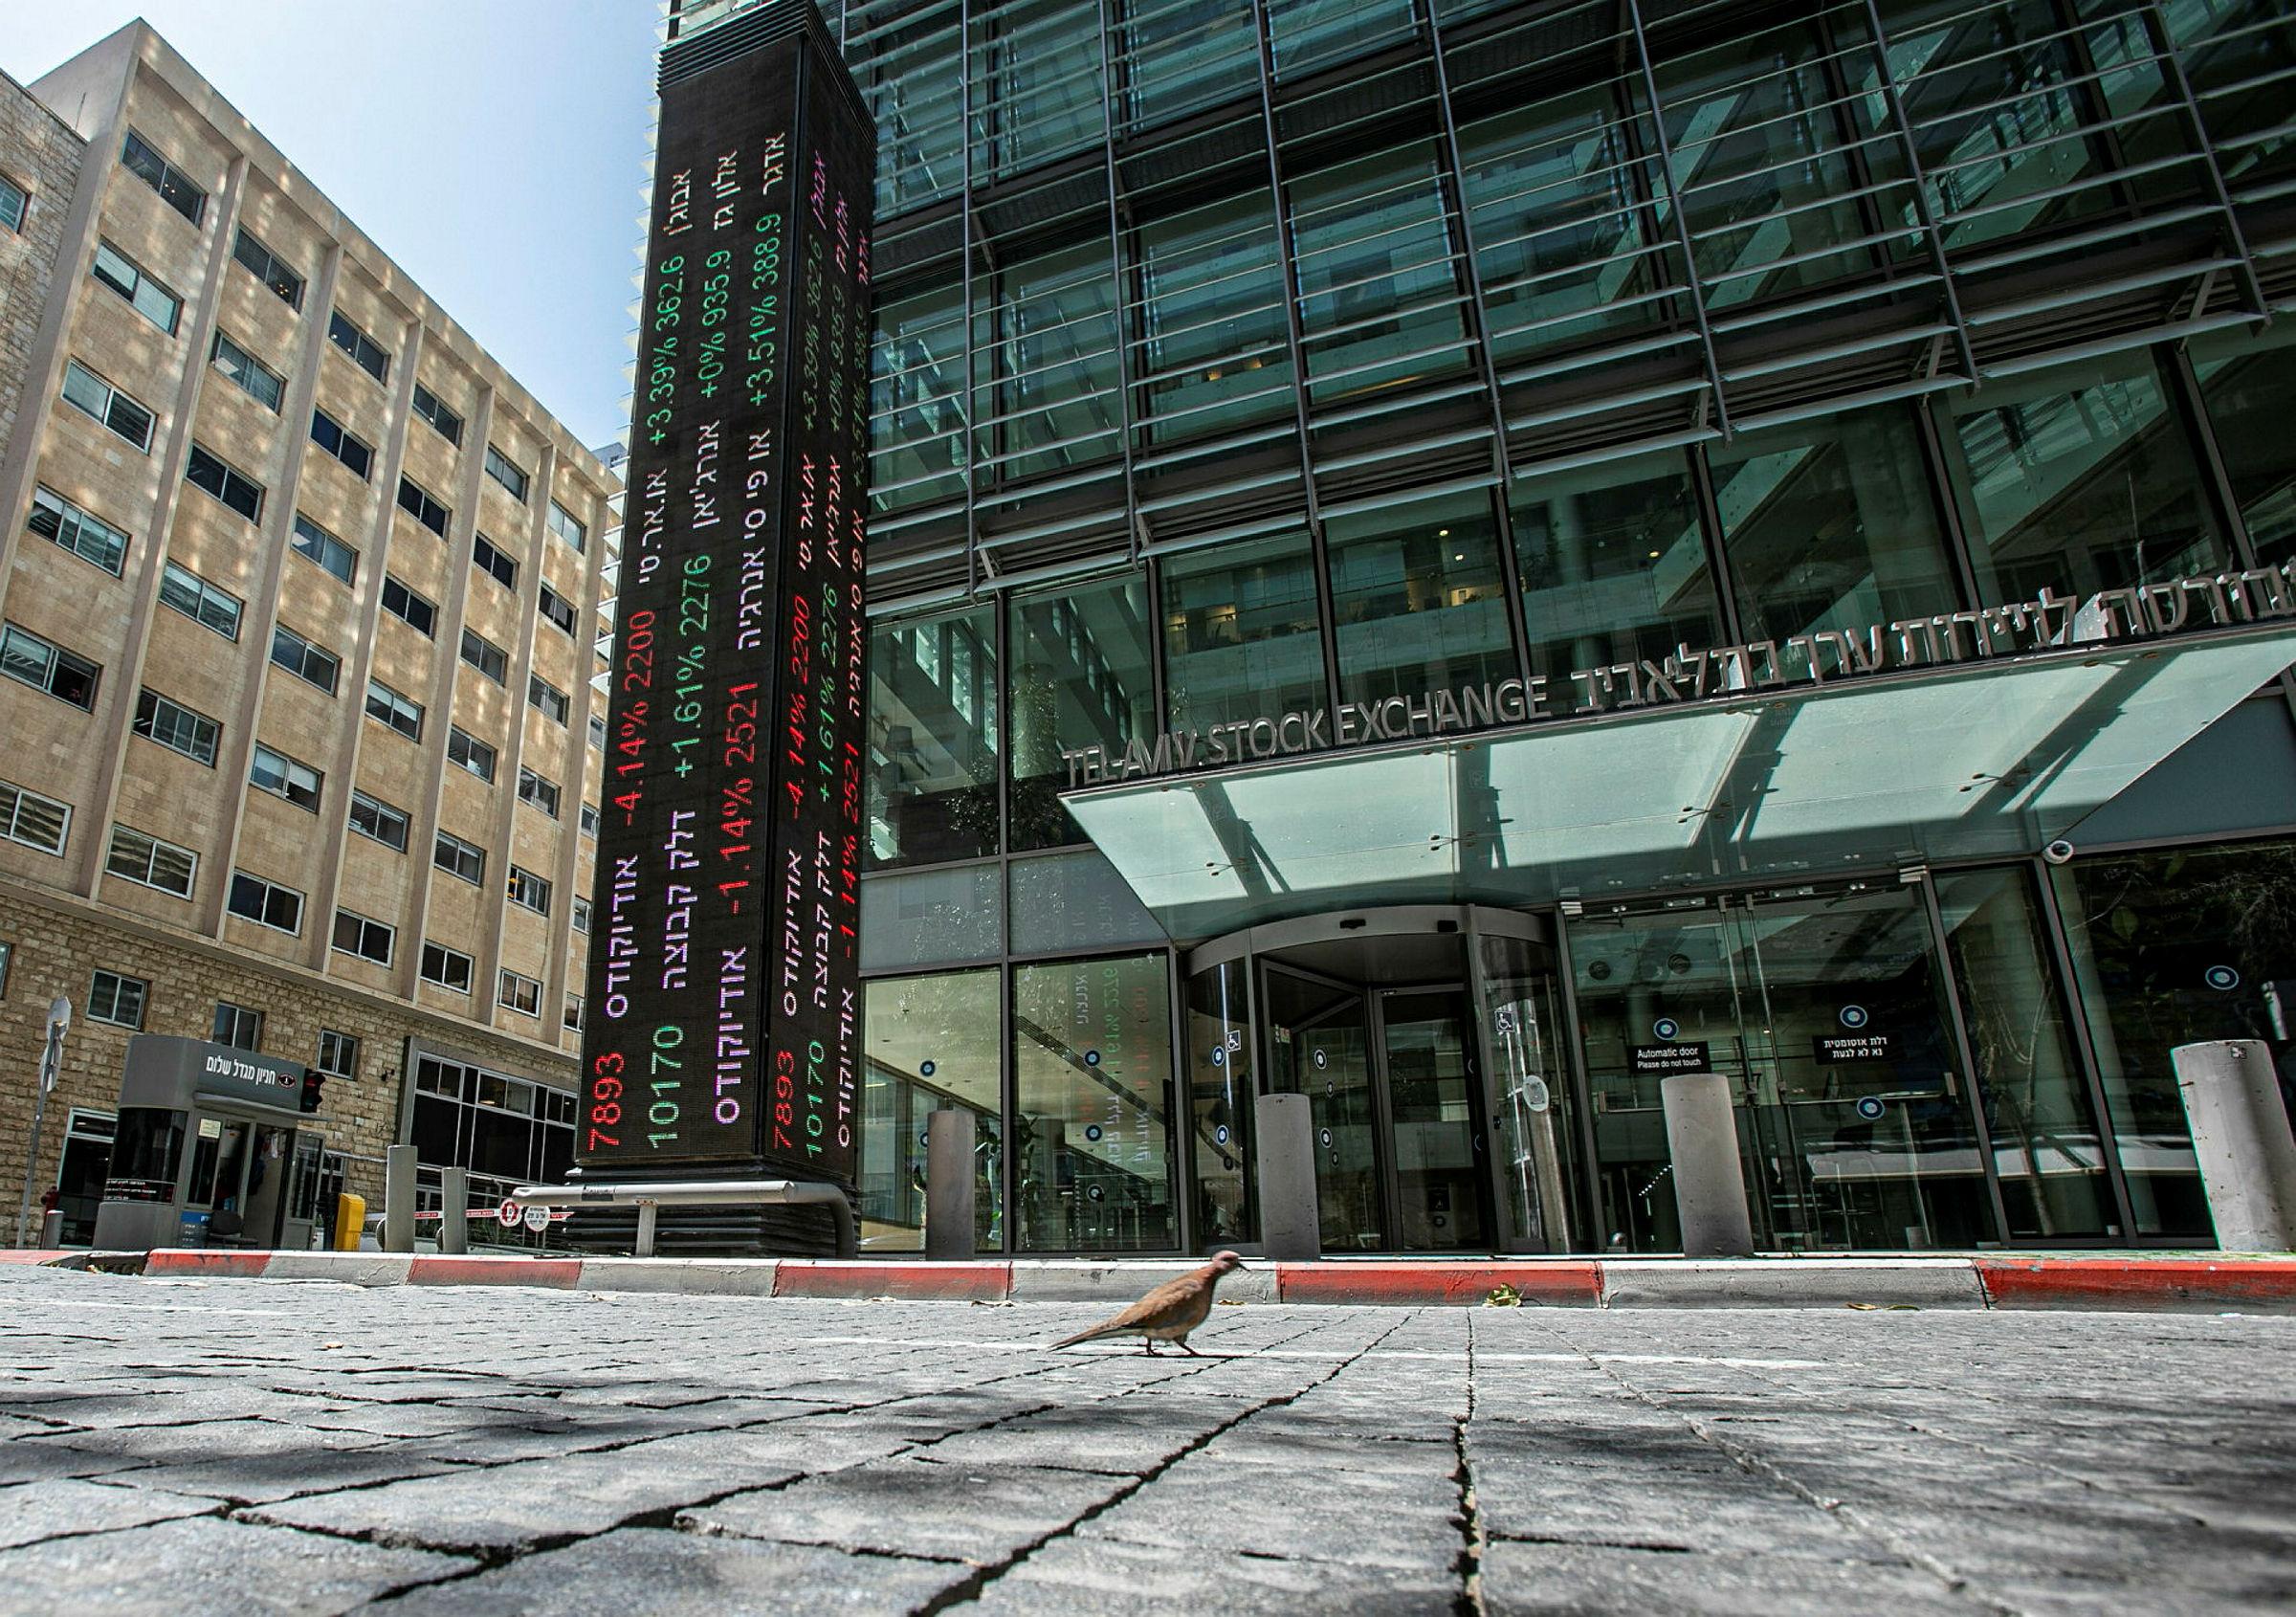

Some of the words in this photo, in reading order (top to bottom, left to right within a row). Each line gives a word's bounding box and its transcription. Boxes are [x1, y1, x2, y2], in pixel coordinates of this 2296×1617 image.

[663, 168, 693, 235] אבוג'ן
[711, 149, 741, 199] אלון
[762, 131, 785, 195] אדגר
[714, 203, 734, 231] גז
[752, 212, 782, 290] 388.9
[655, 255, 685, 332] 362.6
[702, 249, 732, 326] 935.9
[806, 233, 823, 318] 362.6
[697, 331, 726, 398] +0%
[745, 295, 778, 407] +3.51%
[830, 285, 845, 365] 935.9
[647, 337, 678, 446] +3.39%
[689, 419, 721, 529] אנרג'יאן
[746, 470, 768, 498] פי
[748, 428, 770, 461] או
[638, 468, 668, 584] או.אר.טי
[743, 508, 766, 540] סי
[679, 555, 712, 636] 2276
[738, 546, 765, 650] אנרגיה
[821, 582, 838, 668] 2276
[1890, 587, 2078, 668] לניירות
[624, 609, 655, 692] 2200
[792, 595, 811, 686] 2200
[849, 619, 862, 718] אנרגיה
[1787, 625, 1884, 687] ערך
[672, 644, 706, 779] +1.61%
[724, 682, 759, 766] 2521
[818, 673, 837, 802] +1.61%
[1062, 728, 1198, 789] TEL-AVIV
[1207, 708, 1329, 765] STOCK
[1335, 675, 1552, 747] EXCHANGE
[612, 700, 650, 826] -4.14%
[784, 692, 808, 819] -4.14%
[842, 742, 859, 825] 2521
[664, 810, 699, 870] דלק
[718, 777, 754, 915] -1.14%
[815, 831, 833, 897] דלק
[606, 854, 639, 1018] אודיוקודס
[662, 884, 698, 989] קבוצה
[784, 848, 803, 1017] אודיוקודס
[839, 835, 857, 958] -1.14%
[814, 902, 832, 1008] קבוצה
[206, 1054, 232, 1075] שלום
[232, 1058, 255, 1080] מגדל
[255, 1067, 276, 1085] חניון
[715, 945, 751, 1124] אודיוקודס
[838, 987, 855, 1147] אודיוקודס
[1637, 1047, 1678, 1058] Automatic
[1679, 1047, 1699, 1056] door
[1637, 1060, 1660, 1069] Please
[1661, 1059, 1669, 1068] do
[1823, 1038, 1867, 1049] אוטומטית
[1832, 1048, 1855, 1058] לגעת
[1857, 1047, 1869, 1057] לא
[1869, 1036, 1888, 1046] דלת
[1871, 1048, 1884, 1056] נא
[587, 1052, 625, 1151] 7893
[647, 1026, 684, 1149] 10170
[773, 1051, 795, 1149] 7893
[806, 1040, 825, 1158] 10170
